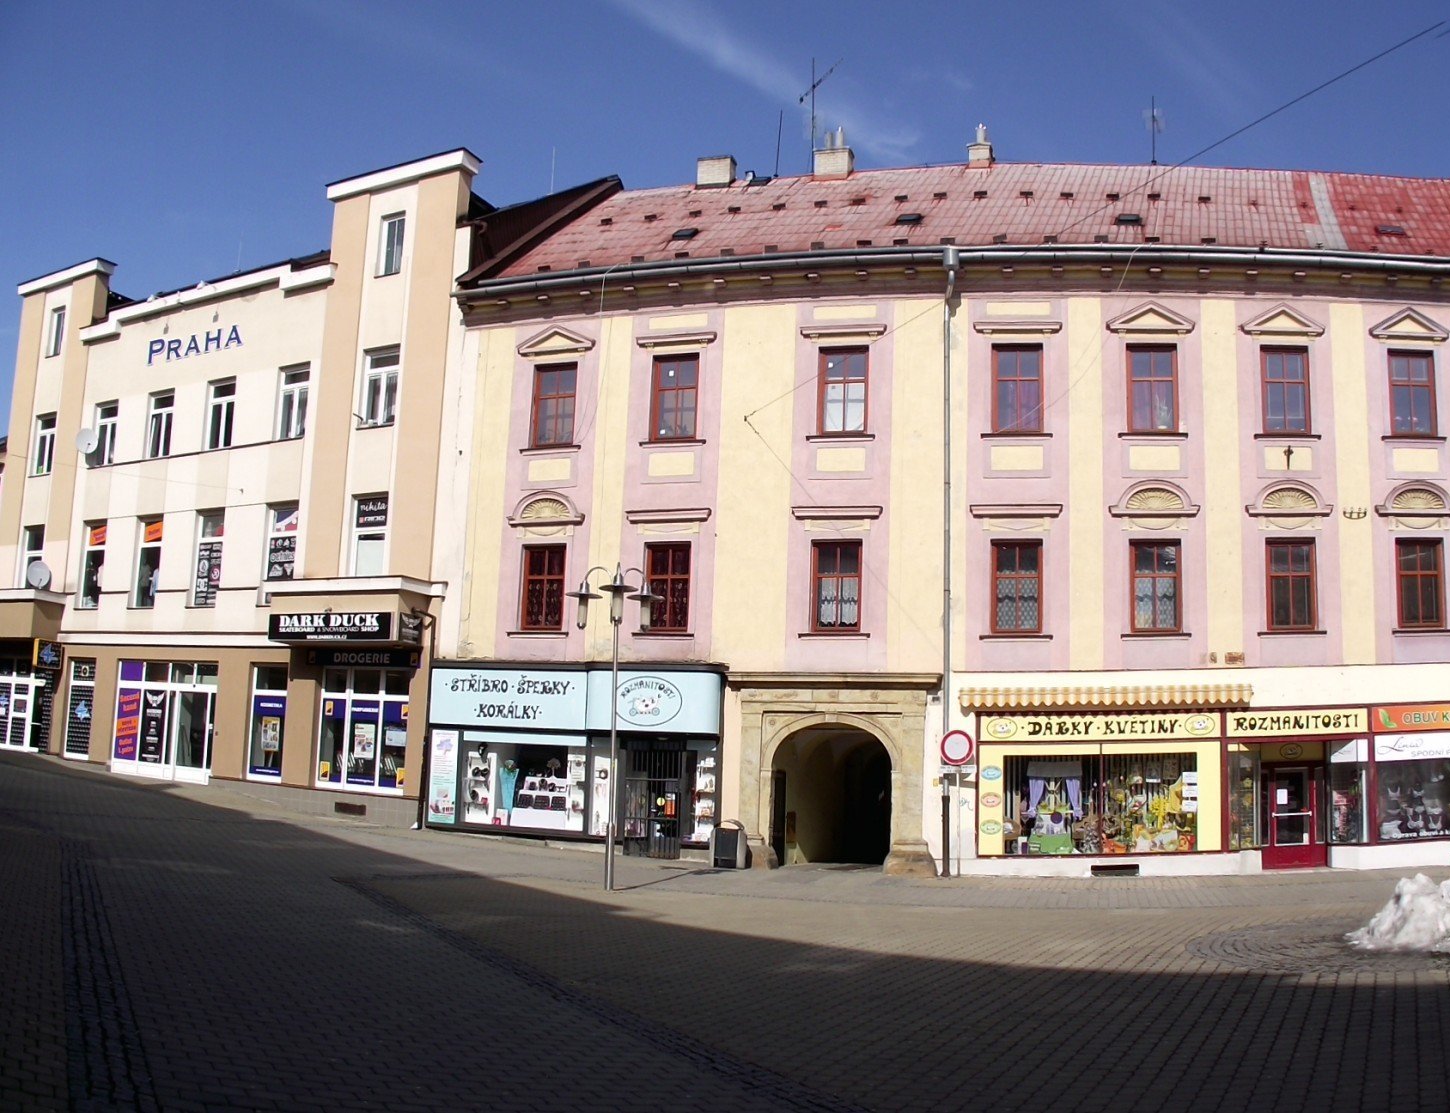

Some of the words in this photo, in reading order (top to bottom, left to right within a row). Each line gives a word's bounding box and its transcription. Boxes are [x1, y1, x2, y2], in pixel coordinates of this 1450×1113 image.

[147, 325, 243, 366] PRAHA
[279, 615, 326, 627] DARK
[329, 614, 380, 627] DUCK
[333, 652, 391, 664] DROGERIE
[450, 673, 509, 693] STŘÍBRO
[516, 674, 571, 695] ŠPERKY
[476, 701, 540, 720] KORÁLKY
[1402, 710, 1437, 724] OBUV
[1027, 717, 1094, 736] DÁRKY
[1103, 718, 1180, 736] KVĚTINY
[1233, 714, 1359, 731] ROZMANITOSTI
